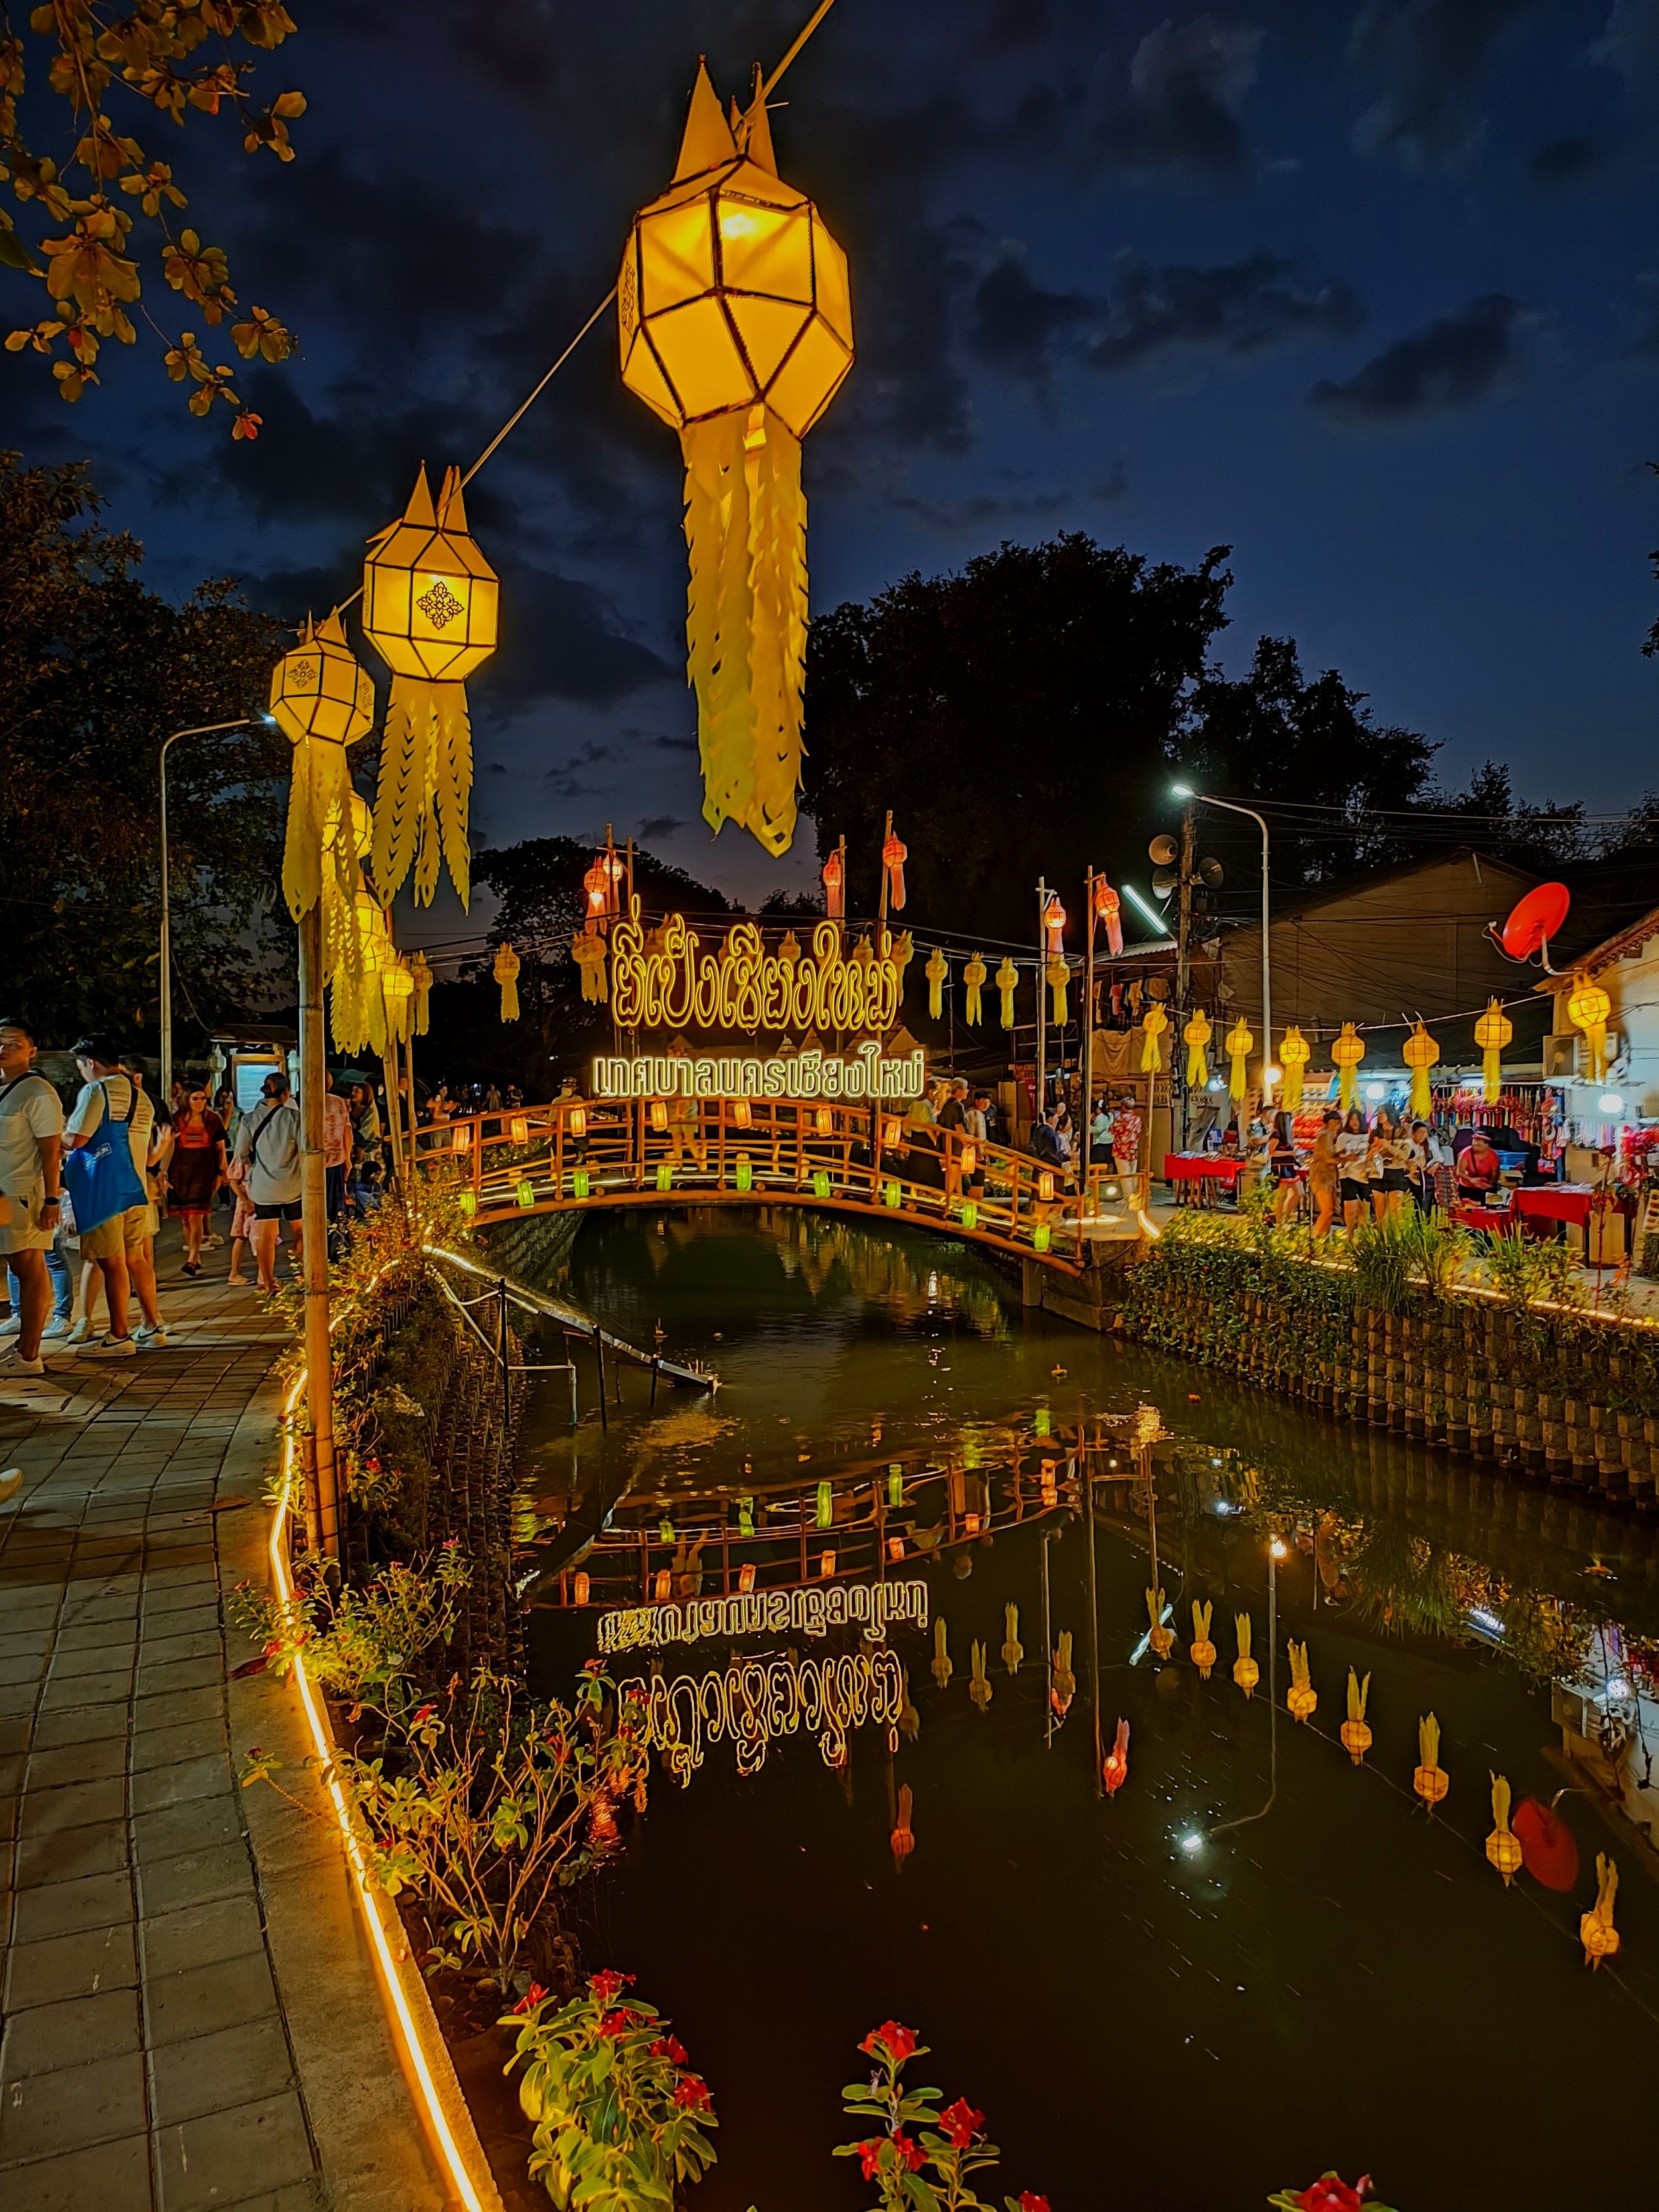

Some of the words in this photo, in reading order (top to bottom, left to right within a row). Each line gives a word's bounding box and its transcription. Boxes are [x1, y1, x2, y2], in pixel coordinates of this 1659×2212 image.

[613, 893, 897, 1030] ยี่เป็งเชียงใหม่
[594, 1041, 924, 1098] เทศบาลนครเชียงใหม่
